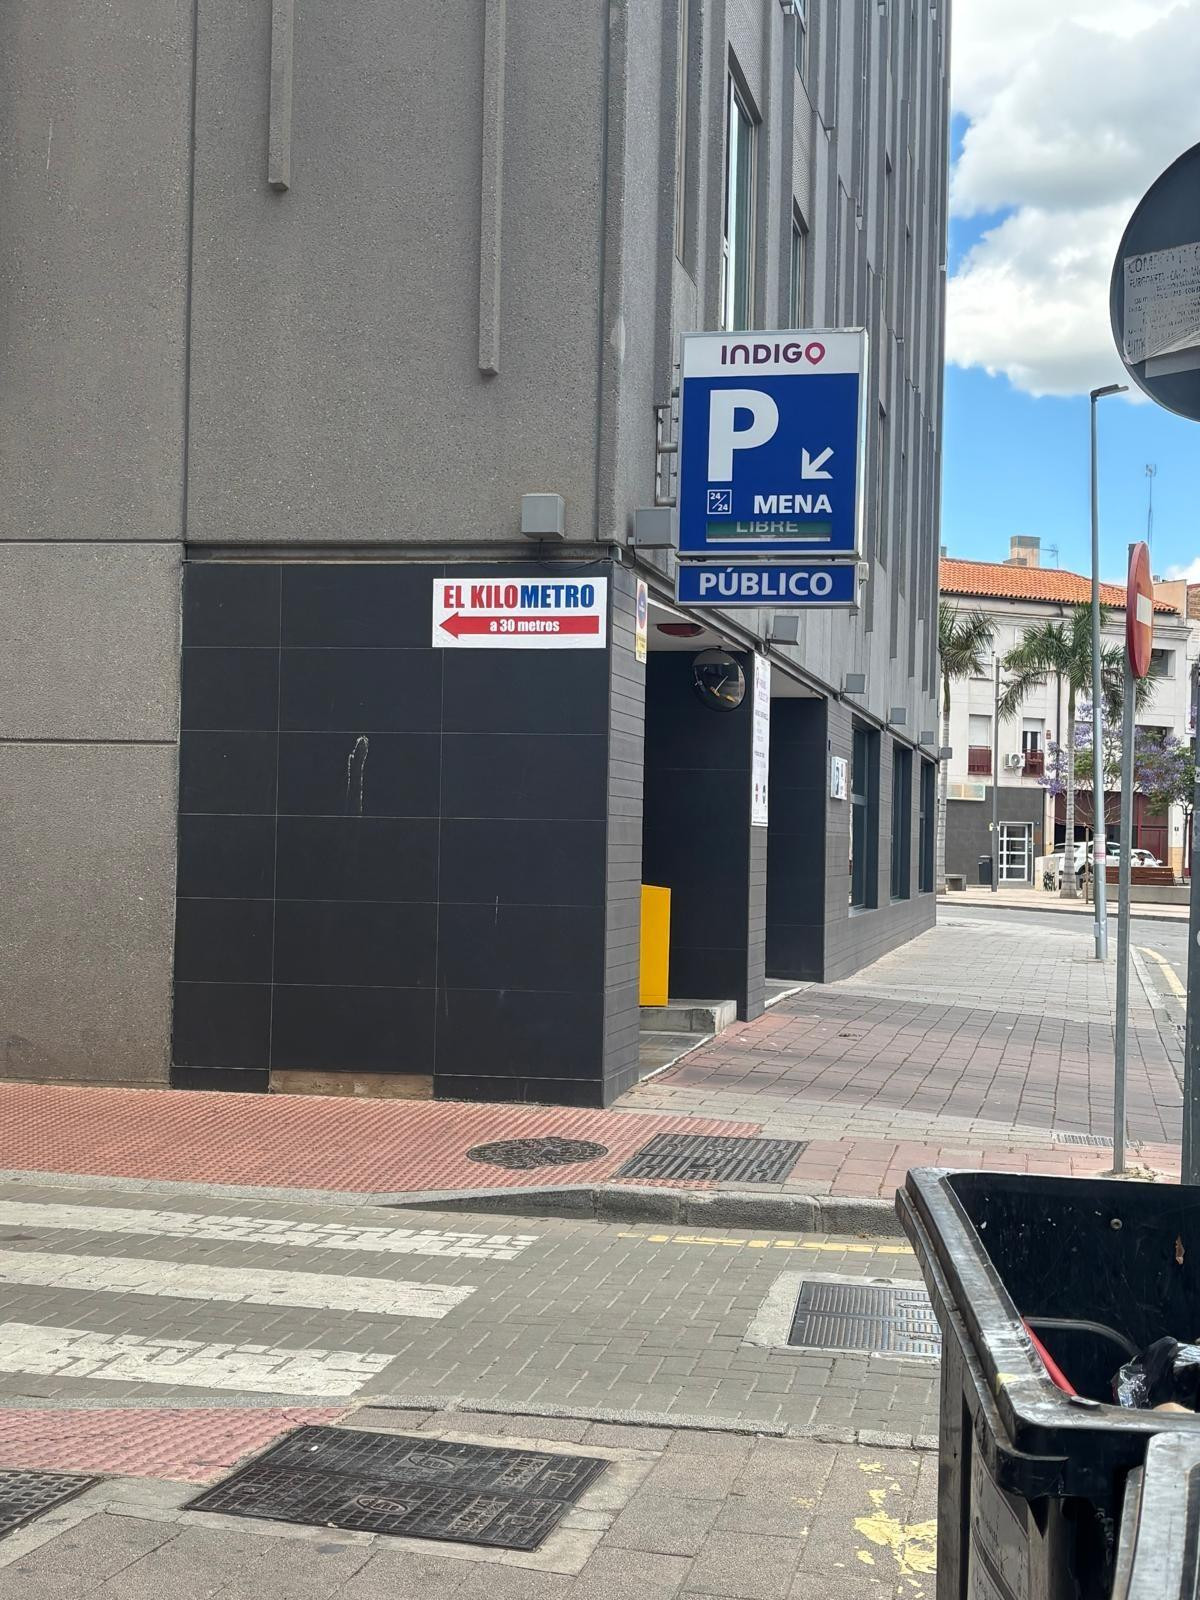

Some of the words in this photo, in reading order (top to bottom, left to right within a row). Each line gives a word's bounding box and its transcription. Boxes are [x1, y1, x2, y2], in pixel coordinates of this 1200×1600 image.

[721, 342, 826, 365] INDIGO
[708, 388, 779, 482] P
[753, 494, 832, 514] MENA
[699, 567, 833, 596] PÚBLICO
[443, 584, 465, 609] EL
[470, 584, 595, 609] KILOMETRO
[489, 621, 498, 632] a
[500, 619, 515, 632] 30
[517, 619, 560, 632] metros
